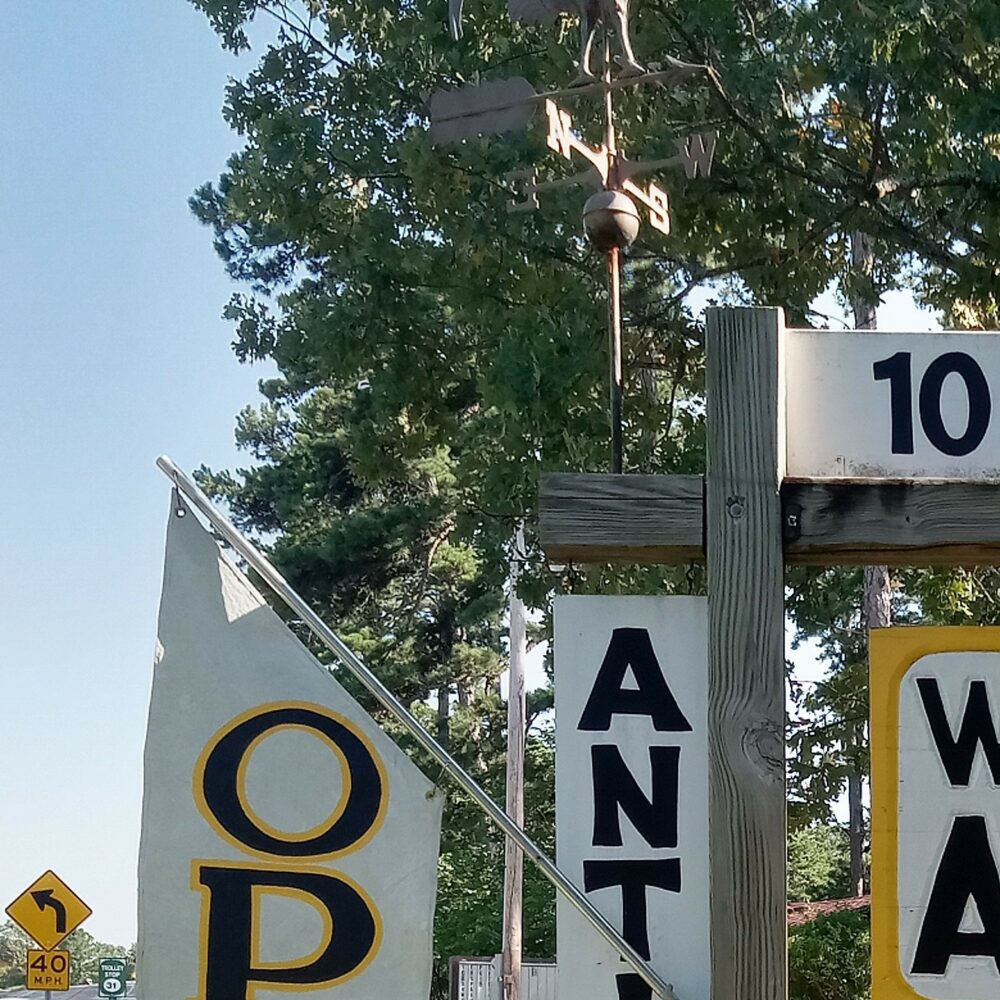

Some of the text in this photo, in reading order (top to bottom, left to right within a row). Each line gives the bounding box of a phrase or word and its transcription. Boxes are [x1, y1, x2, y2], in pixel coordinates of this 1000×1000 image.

[873, 352, 991, 456] 10
[30, 954, 66, 973] 40
[101, 964, 124, 972] TROLLEY
[105, 981, 117, 989] 31
